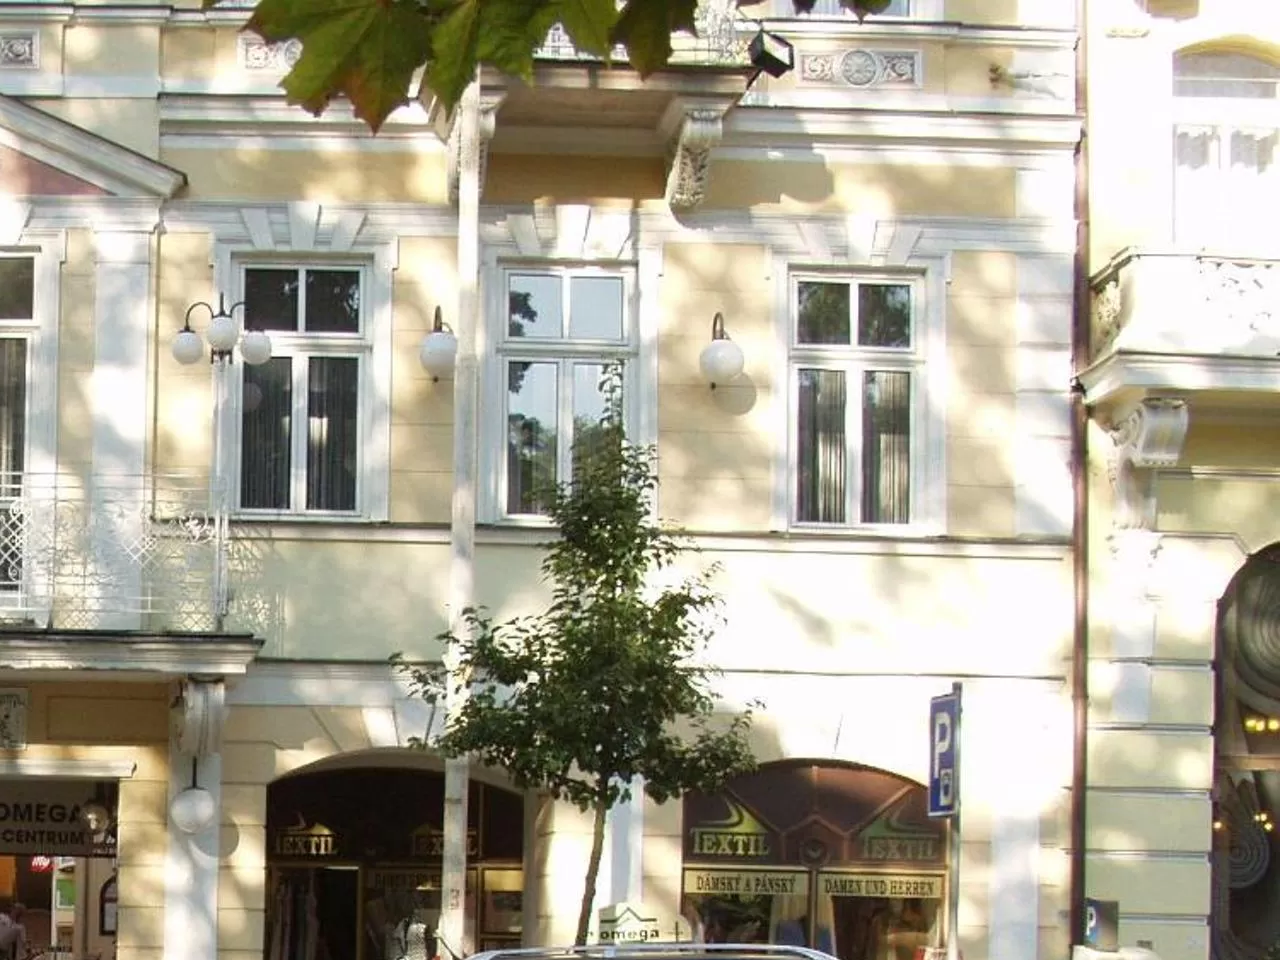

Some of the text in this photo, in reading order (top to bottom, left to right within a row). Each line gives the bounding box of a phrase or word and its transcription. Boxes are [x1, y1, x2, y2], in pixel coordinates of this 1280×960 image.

[934, 711, 951, 779] P
[0, 828, 85, 845] CENTRUM
[690, 828, 770, 856] TEXTIL
[862, 836, 939, 860] TEXTIL
[696, 874, 797, 894] DÁMSKÝ A PÁNSKÝ
[824, 877, 935, 896] DAMEN UND HERREN
[600, 928, 660, 941] omega
